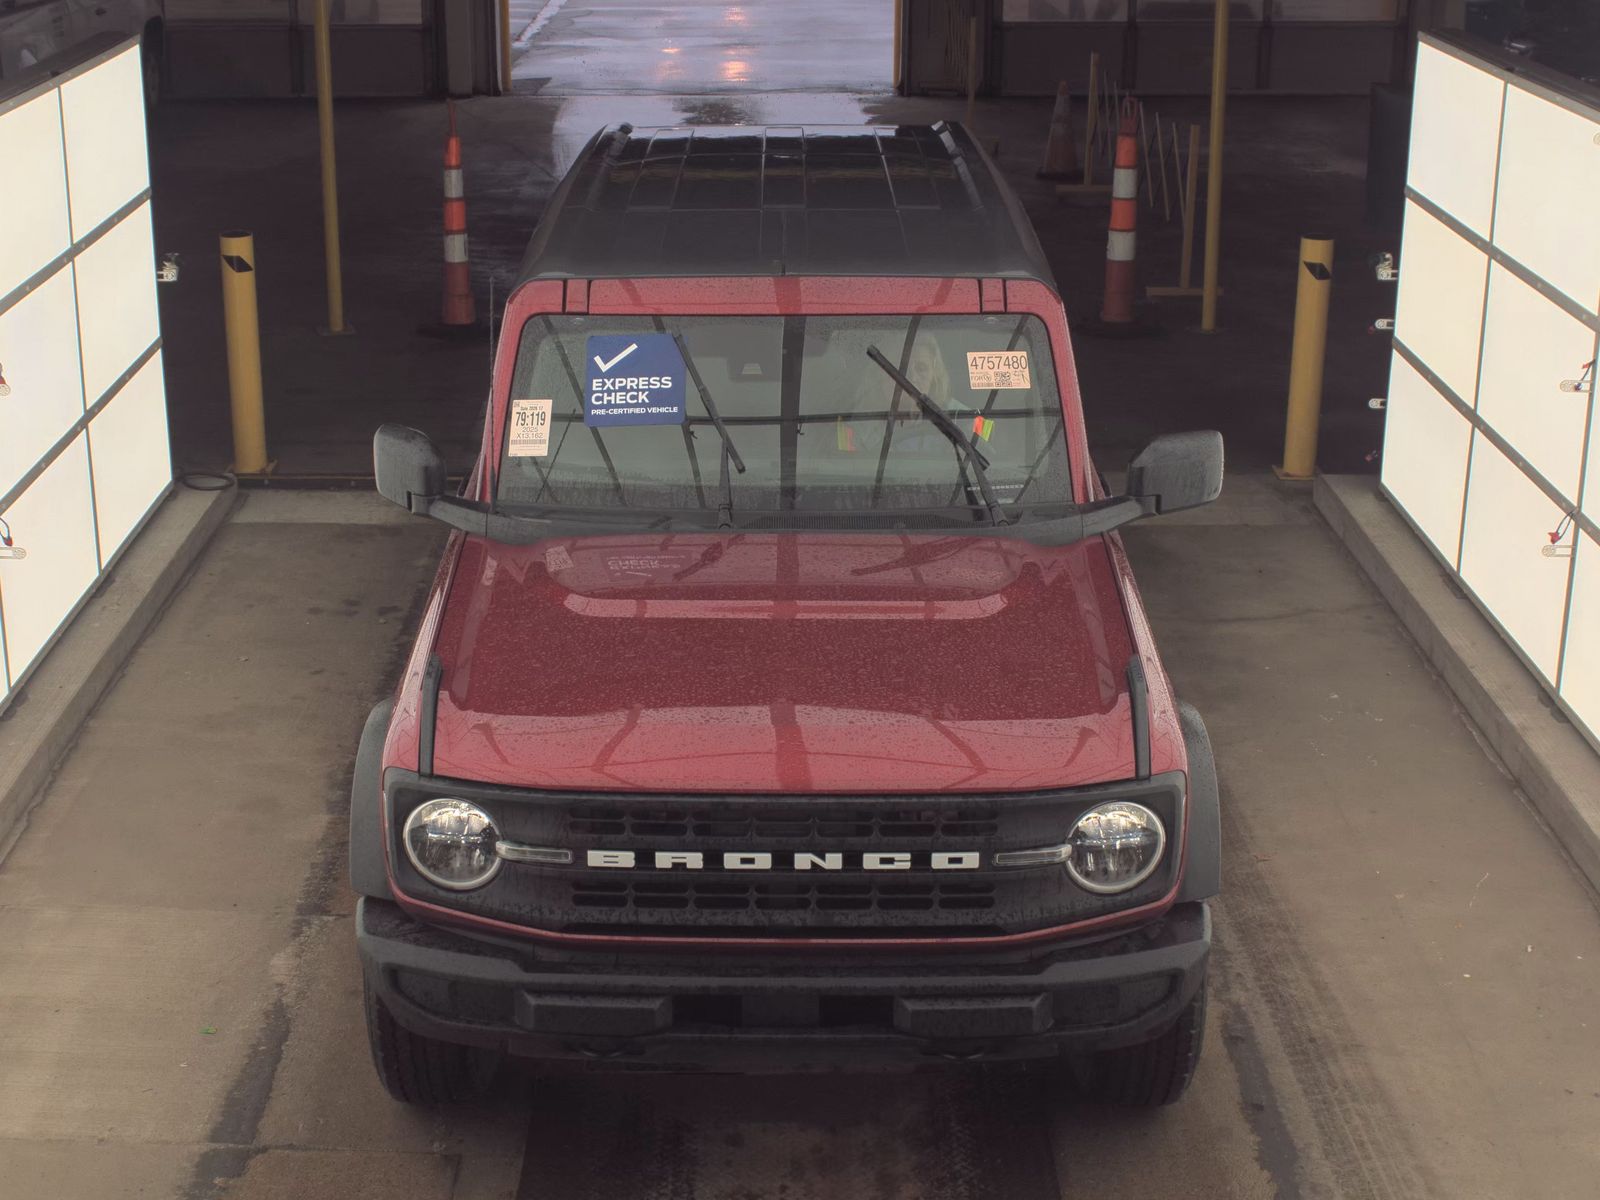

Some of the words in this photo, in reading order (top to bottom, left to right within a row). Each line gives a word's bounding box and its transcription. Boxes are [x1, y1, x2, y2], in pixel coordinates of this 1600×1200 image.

[970, 355, 1027, 370] 4757480
[592, 377, 672, 391] EXPRESS
[591, 391, 649, 405] CHECK
[591, 407, 646, 415] PRE-CERTIFIED
[516, 411, 546, 426] 79:119
[587, 850, 980, 871] BRONCO
